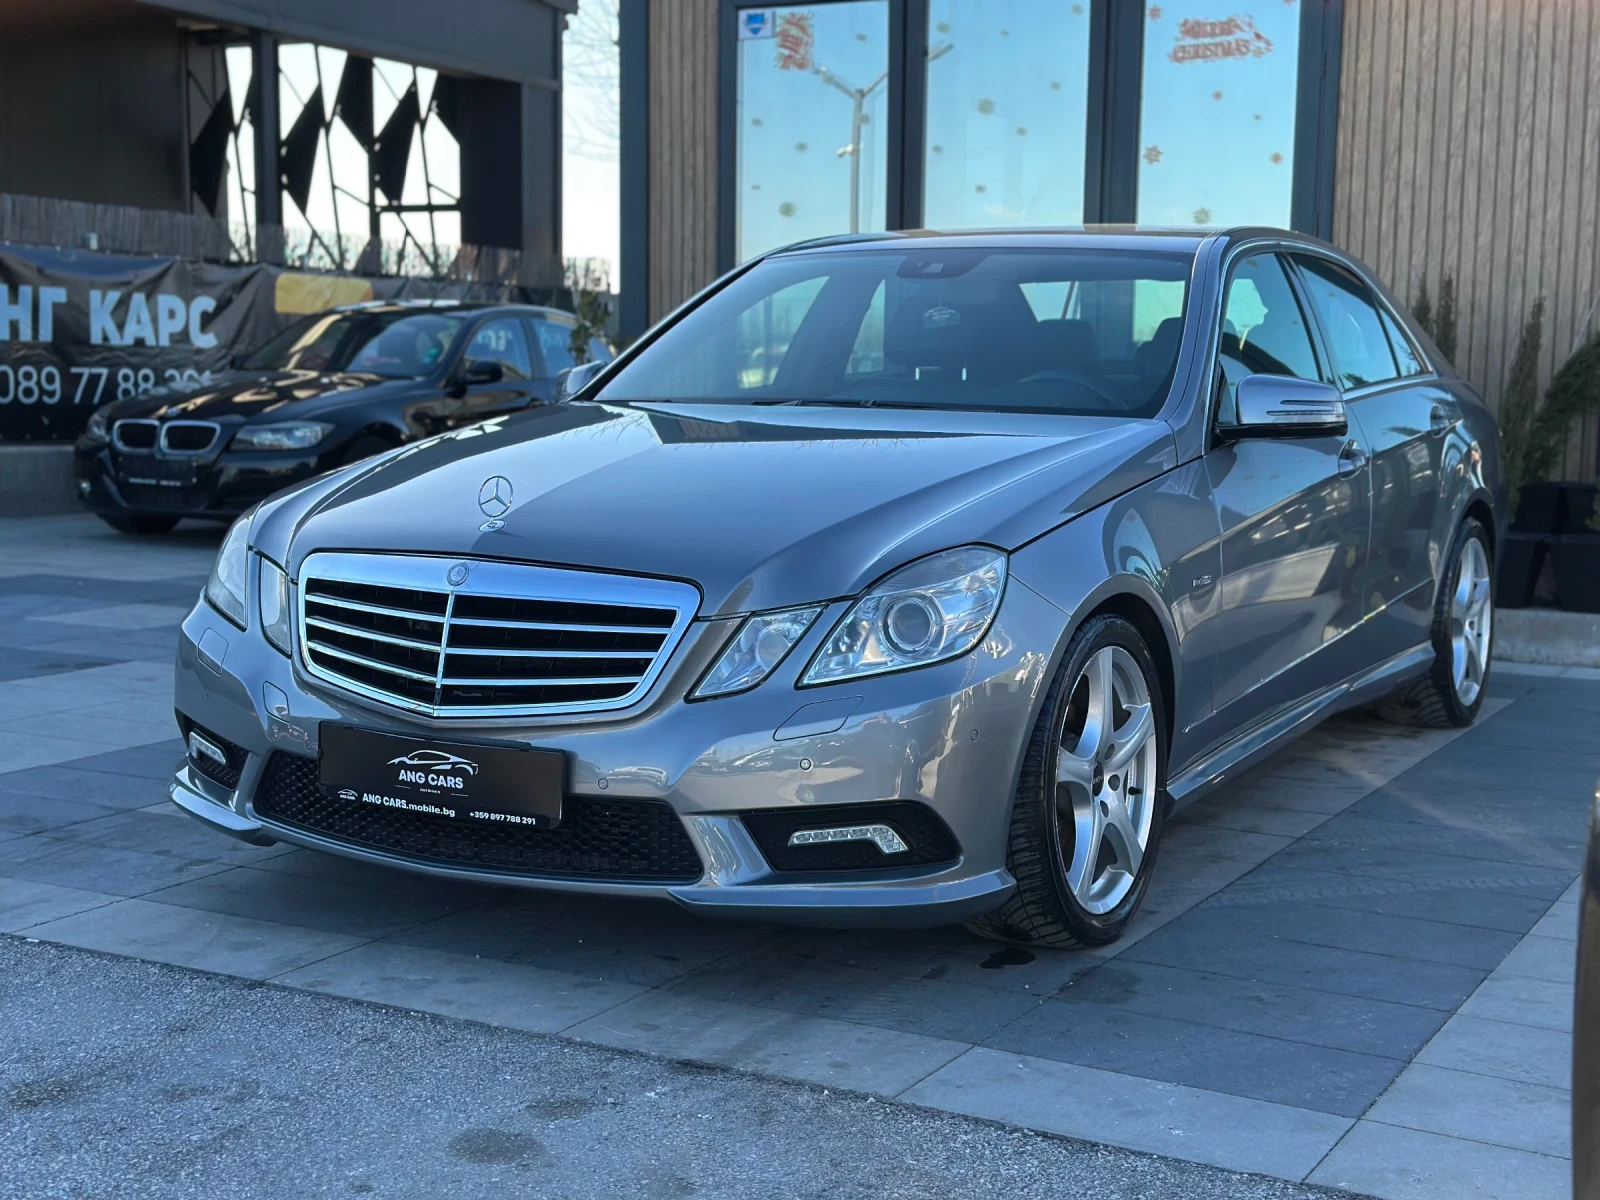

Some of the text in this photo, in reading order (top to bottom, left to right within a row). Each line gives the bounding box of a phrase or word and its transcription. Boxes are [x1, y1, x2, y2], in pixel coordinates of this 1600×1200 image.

[89, 288, 218, 349] КАРС
[0, 364, 61, 405] 089
[70, 366, 109, 405] 77
[117, 367, 156, 402] 88
[398, 769, 464, 789] ANG CARS
[362, 792, 456, 818] ANG CARS.mobile.bg
[469, 811, 536, 826] +359 897 788 291
